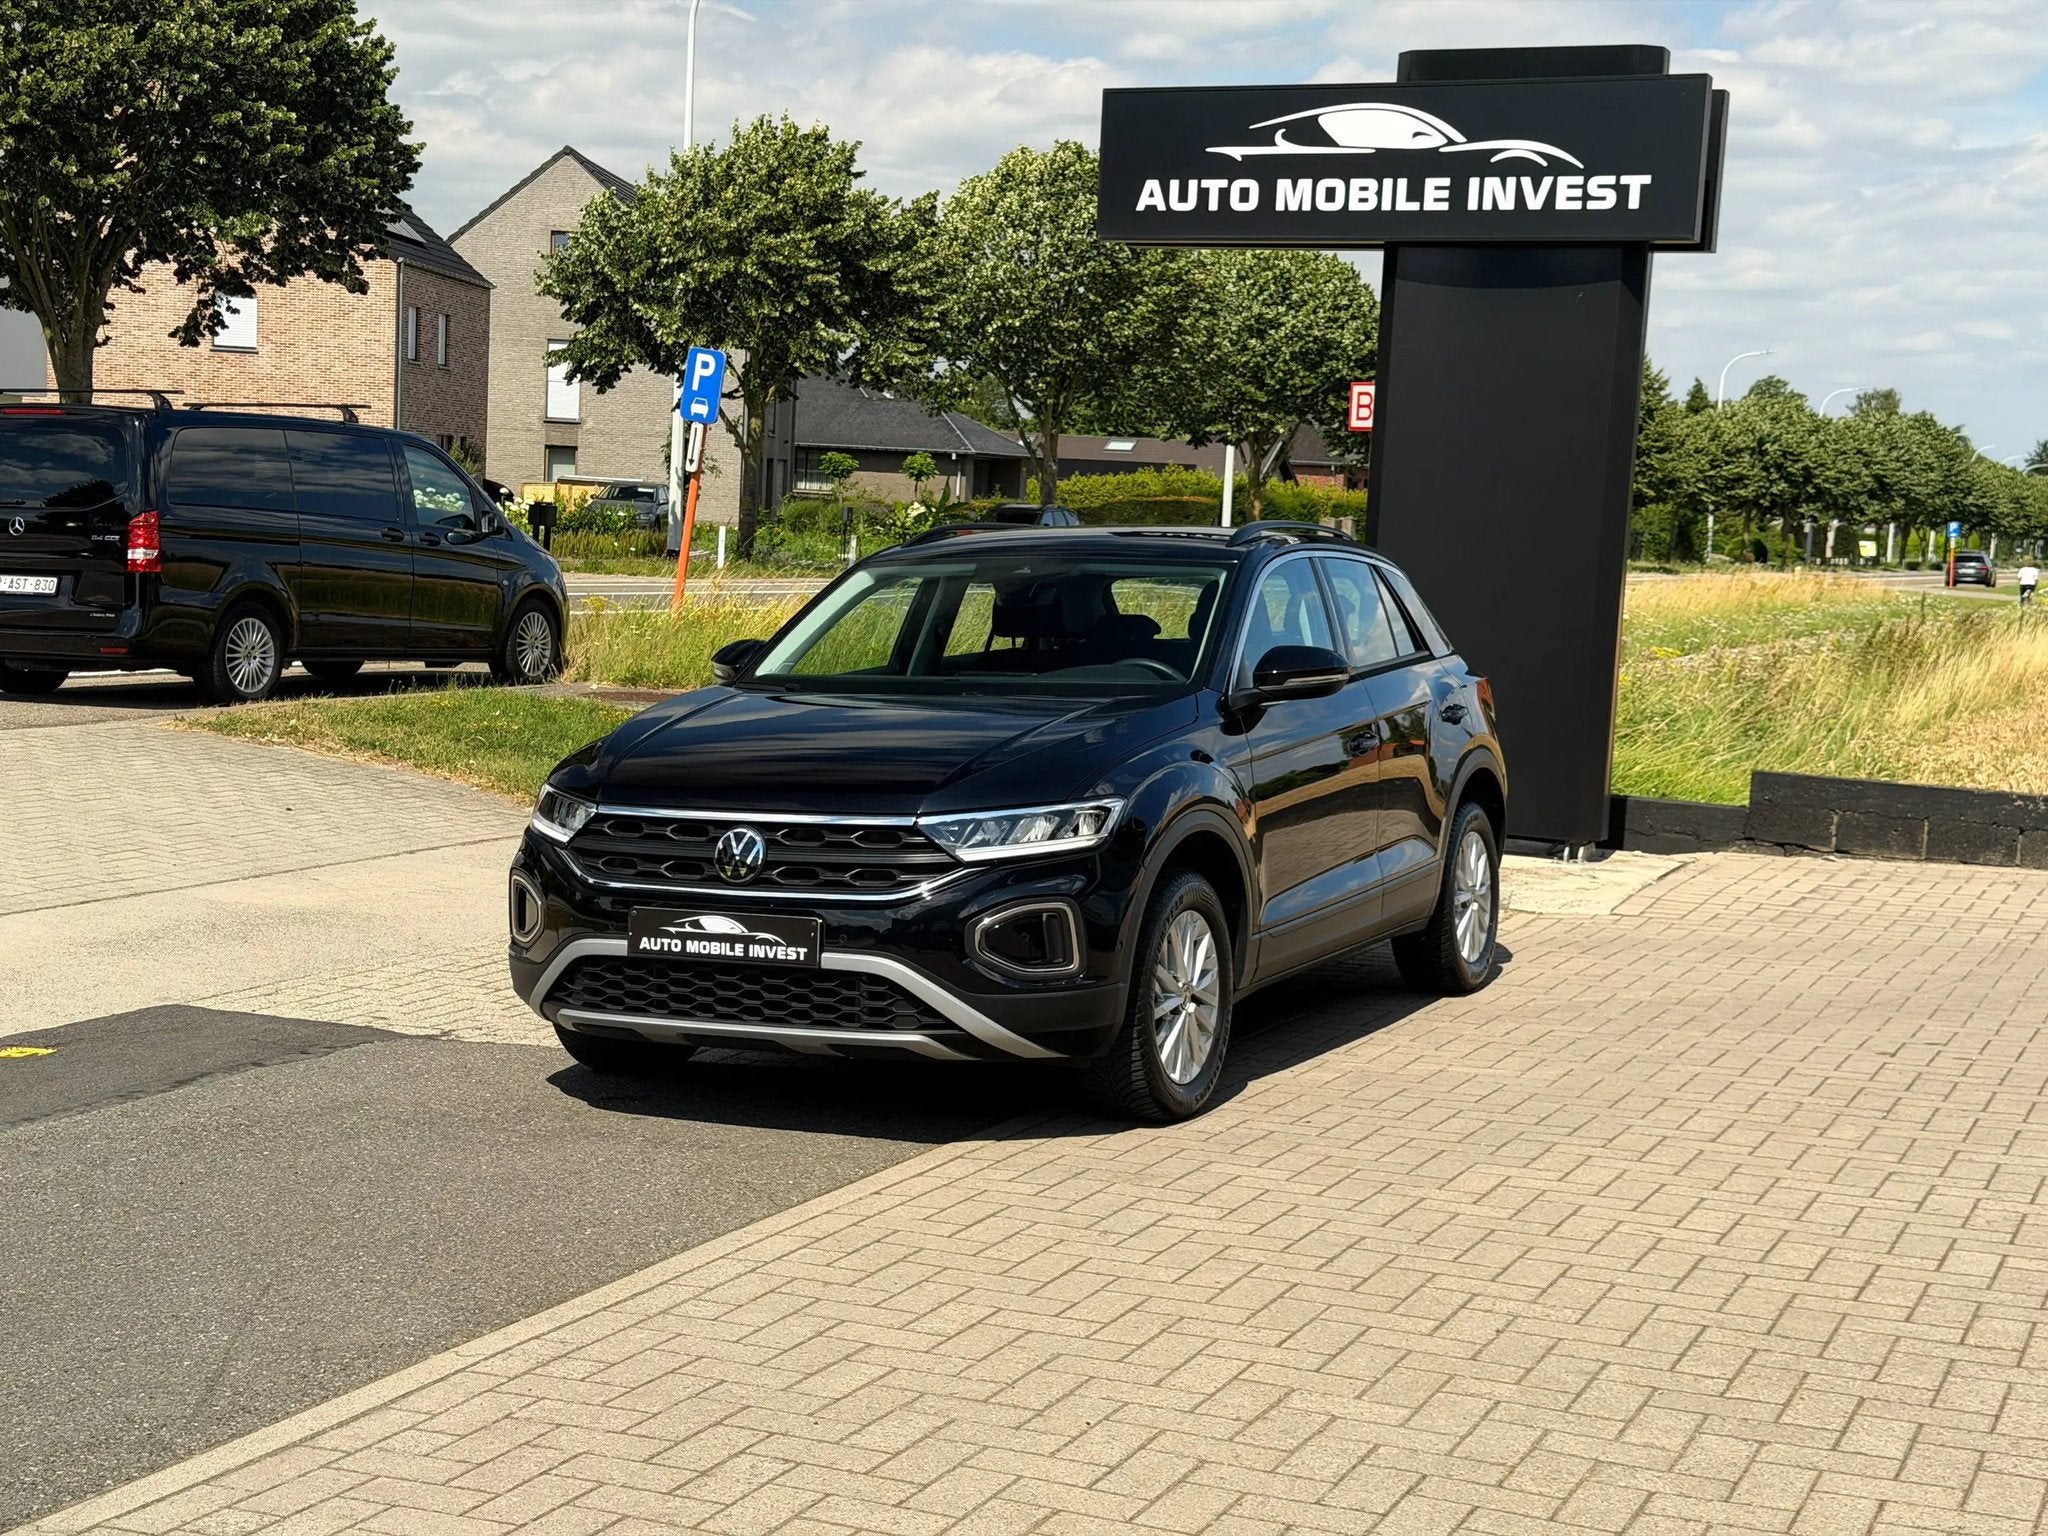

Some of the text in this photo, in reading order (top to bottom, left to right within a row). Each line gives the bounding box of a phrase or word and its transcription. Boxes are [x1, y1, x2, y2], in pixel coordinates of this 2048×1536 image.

[1135, 174, 1653, 212] AUTO MOBILE INVEST
[692, 352, 716, 392] P
[1356, 391, 1373, 421] B
[639, 936, 808, 961] AUTO MOBILE INVEST
